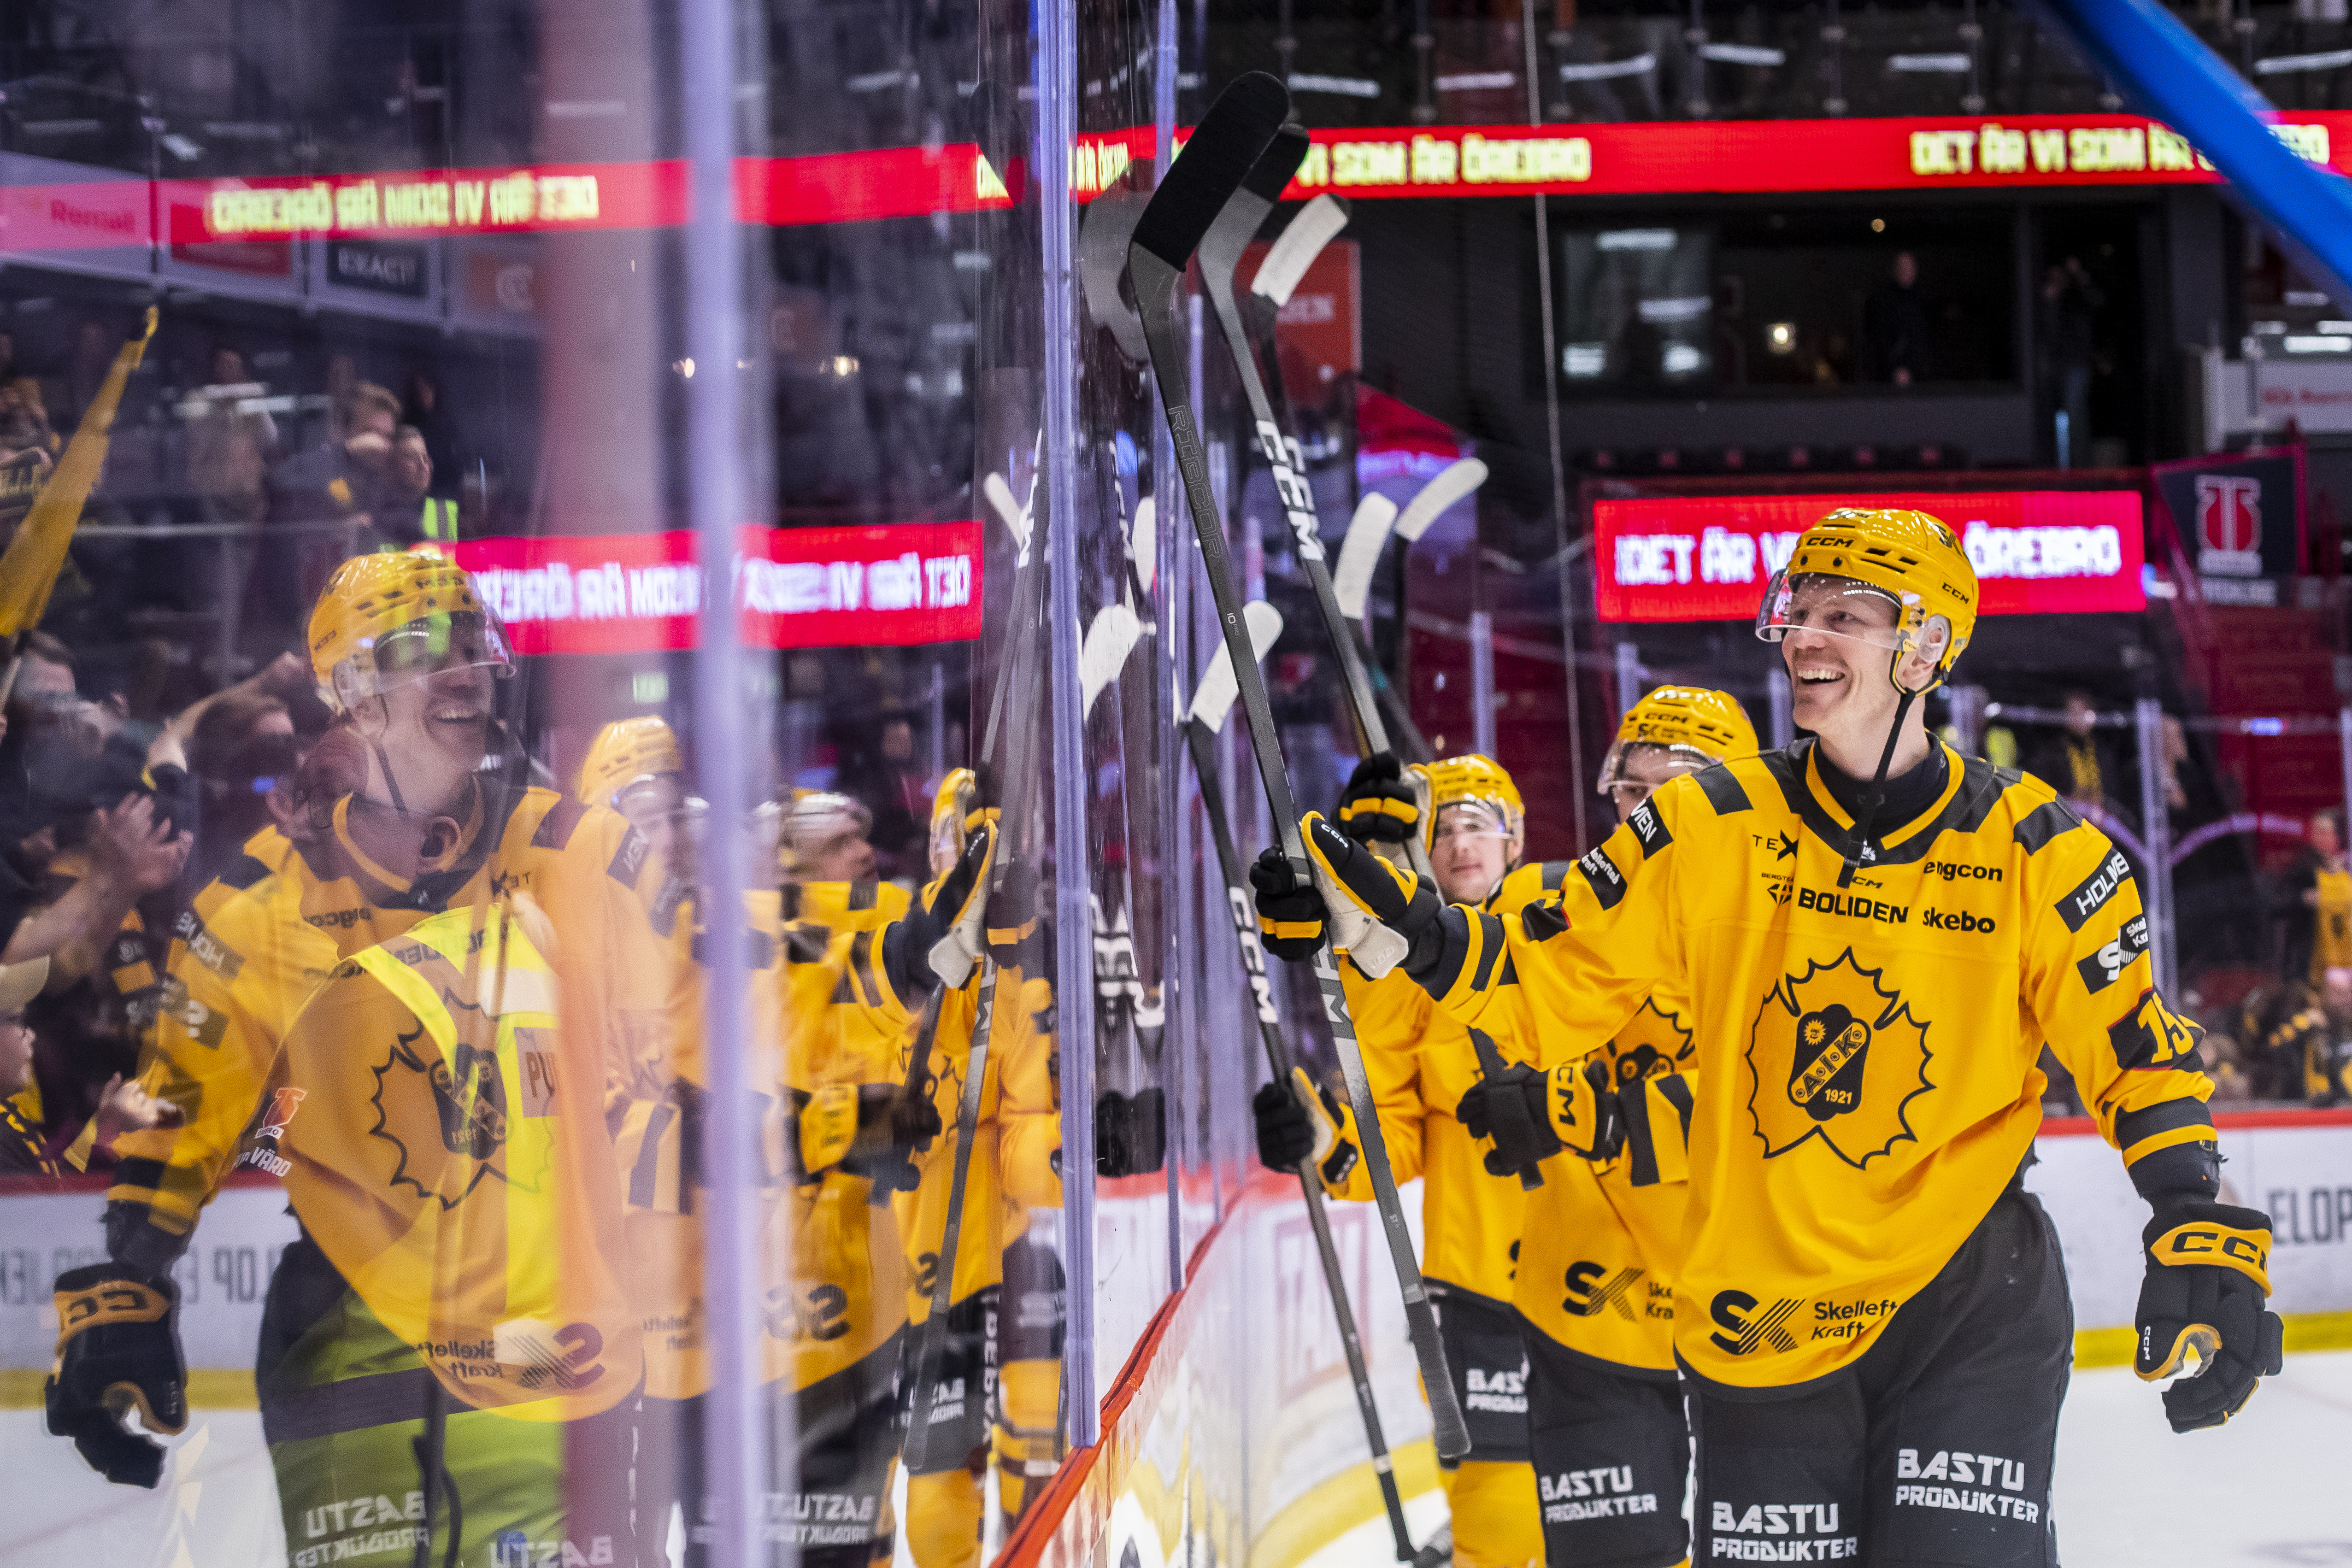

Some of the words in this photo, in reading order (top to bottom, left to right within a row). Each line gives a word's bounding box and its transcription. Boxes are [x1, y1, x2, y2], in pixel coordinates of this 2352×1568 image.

[1168, 405, 1223, 559] RIBCOR
[1256, 420, 1324, 560] CCM
[1806, 537, 1855, 548] CCM
[1942, 582, 1970, 605] CCM
[1798, 887, 1909, 924] BOLIDEN
[1229, 887, 1278, 1024] CCM
[1824, 1088, 1852, 1105] 1921
[1811, 1321, 1865, 1341] Kraft
[1540, 1465, 1634, 1502] BASTU
[1898, 1448, 2025, 1492] BASTU
[1711, 1502, 1839, 1534] BASTU
[1895, 1485, 2040, 1524] PRODUKTER
[1711, 1536, 1858, 1562] PRODUKTER
